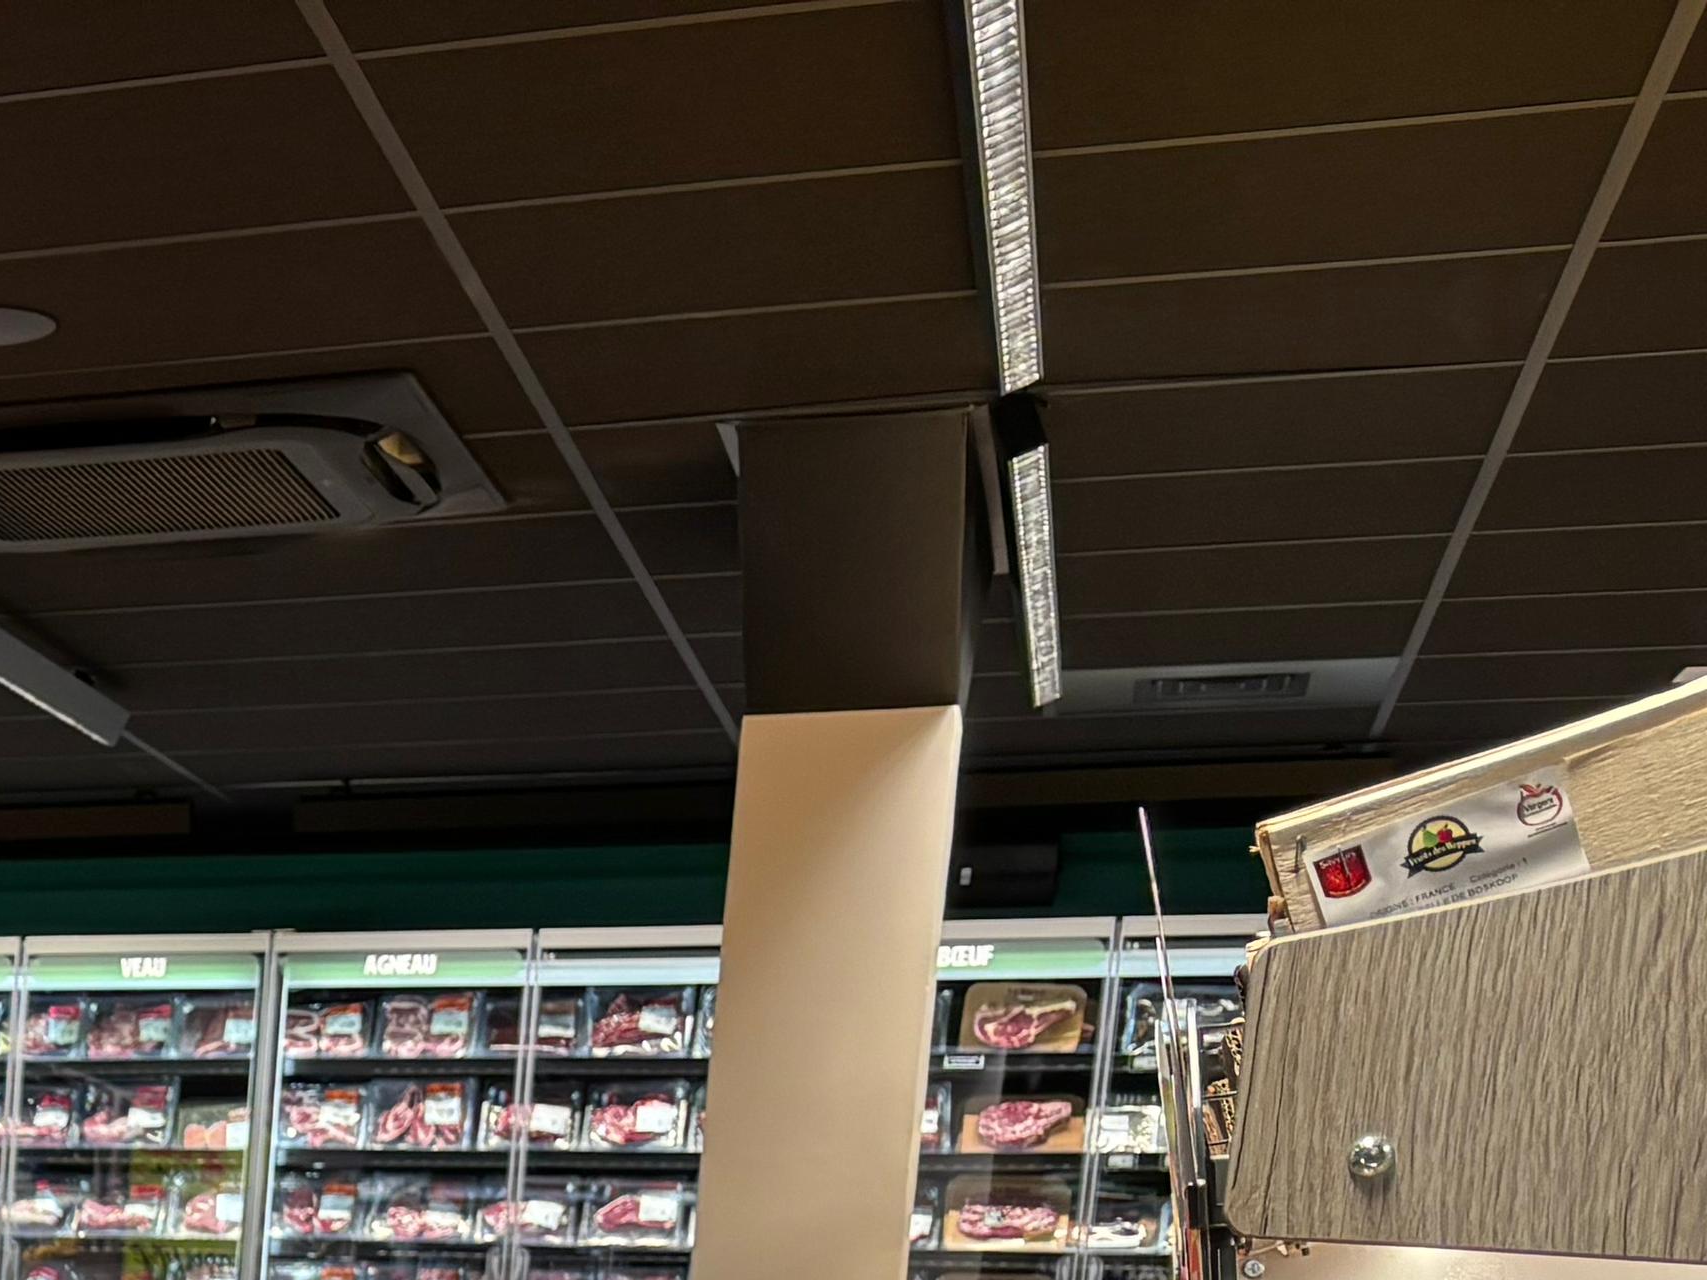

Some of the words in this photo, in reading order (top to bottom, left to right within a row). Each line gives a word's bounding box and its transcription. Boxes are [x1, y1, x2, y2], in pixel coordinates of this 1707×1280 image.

[1415, 883, 1456, 901] FRANCE
[120, 957, 167, 978] VEAU
[363, 953, 438, 976] AGNEAU
